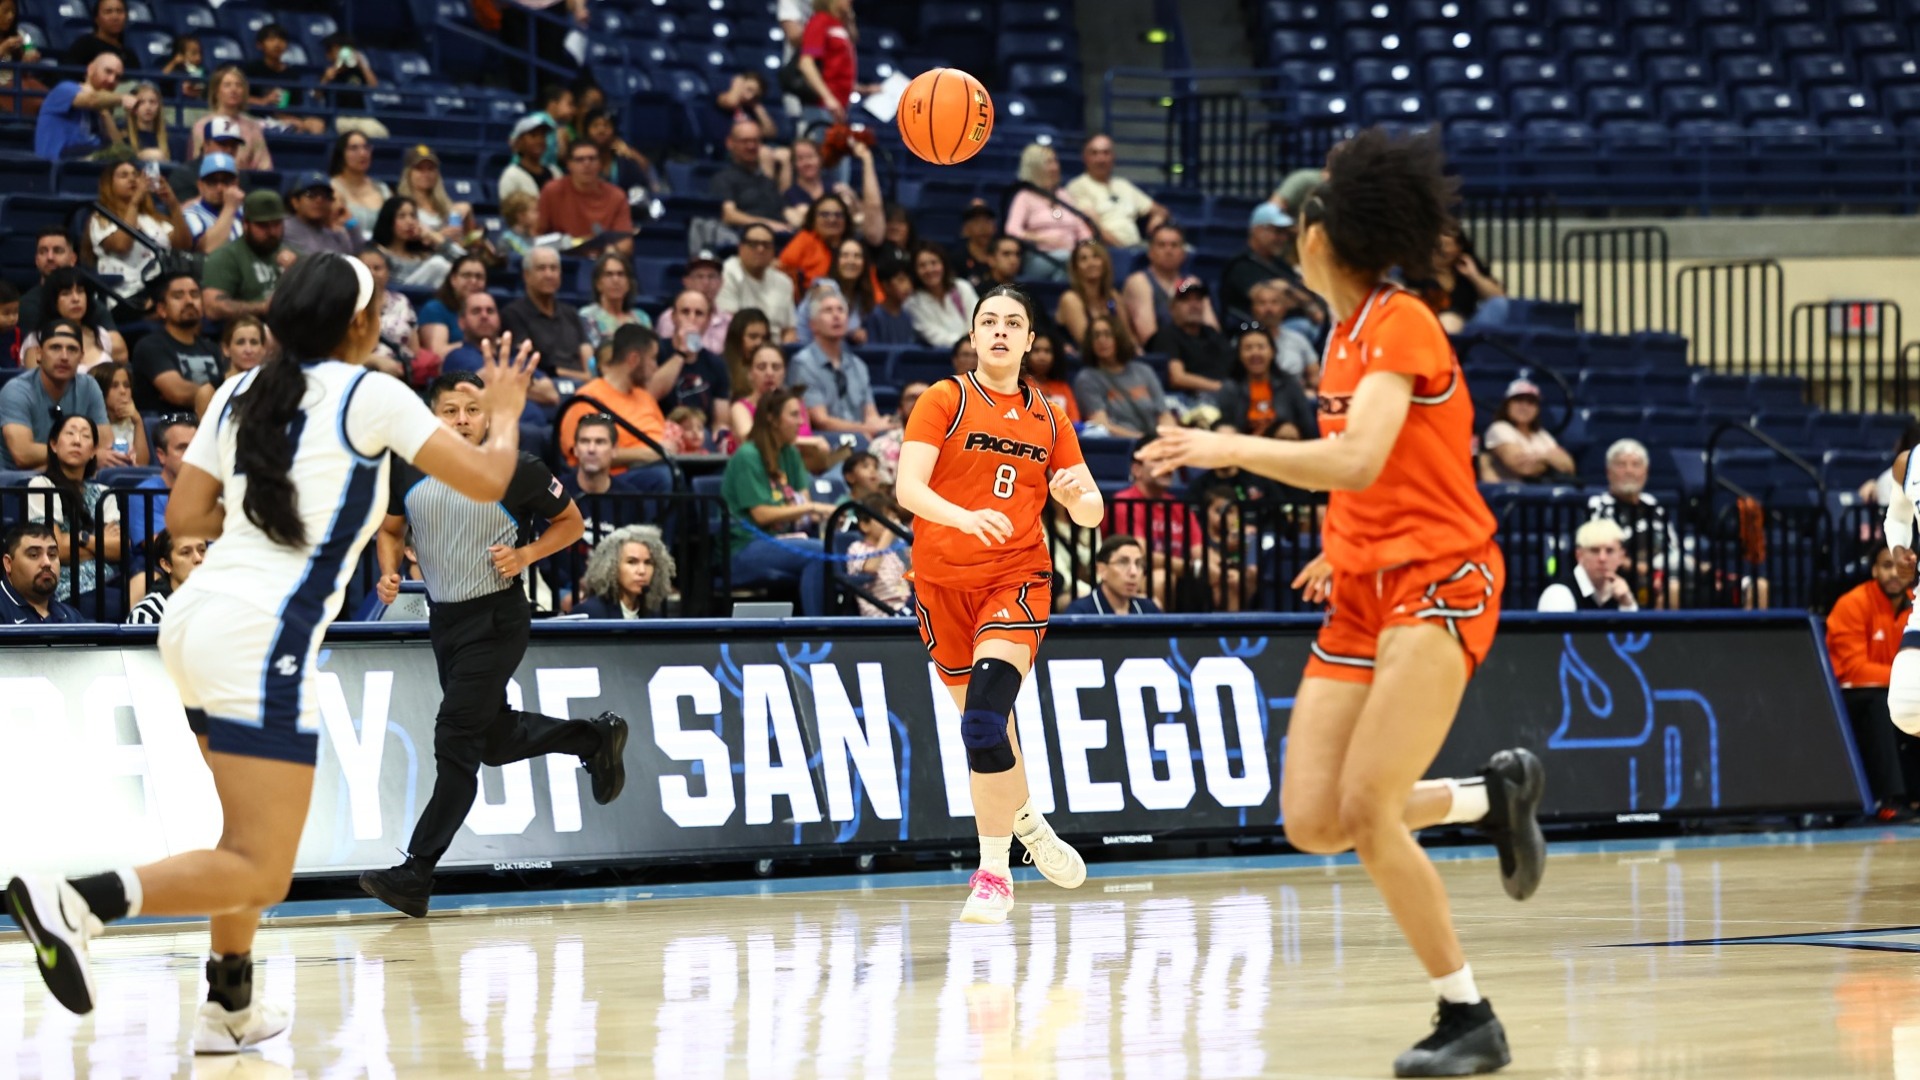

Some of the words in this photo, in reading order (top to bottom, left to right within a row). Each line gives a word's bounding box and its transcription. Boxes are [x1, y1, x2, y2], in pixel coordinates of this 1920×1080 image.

[969, 89, 988, 142] ELITE
[963, 431, 1048, 463] PACIFIC
[992, 463, 1017, 500] 8
[647, 662, 903, 828] SAN
[494, 860, 553, 871] DAKTRONICS
